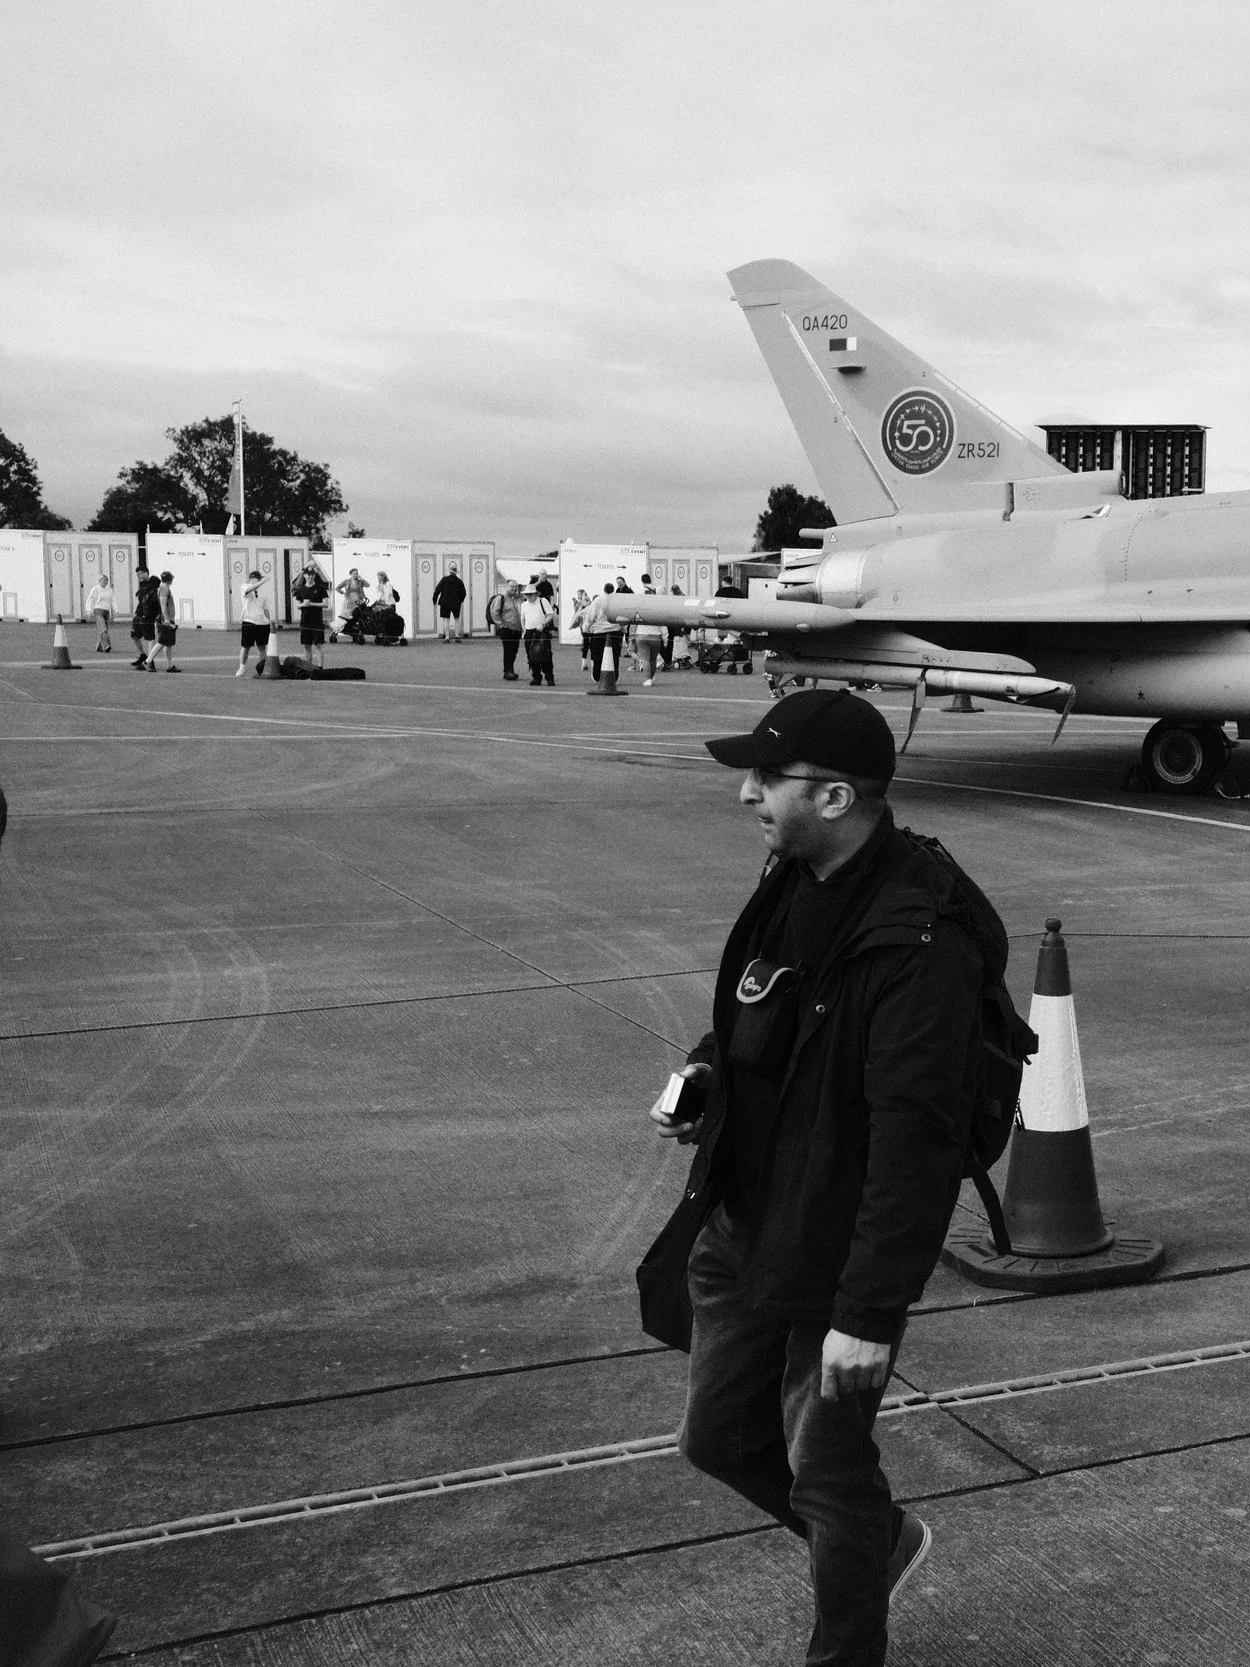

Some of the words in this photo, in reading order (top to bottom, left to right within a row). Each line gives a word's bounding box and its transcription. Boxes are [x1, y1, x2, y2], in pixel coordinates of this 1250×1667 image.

[802, 314, 848, 331] QA420
[895, 419, 935, 452] 50
[957, 442, 1000, 459] ZR521
